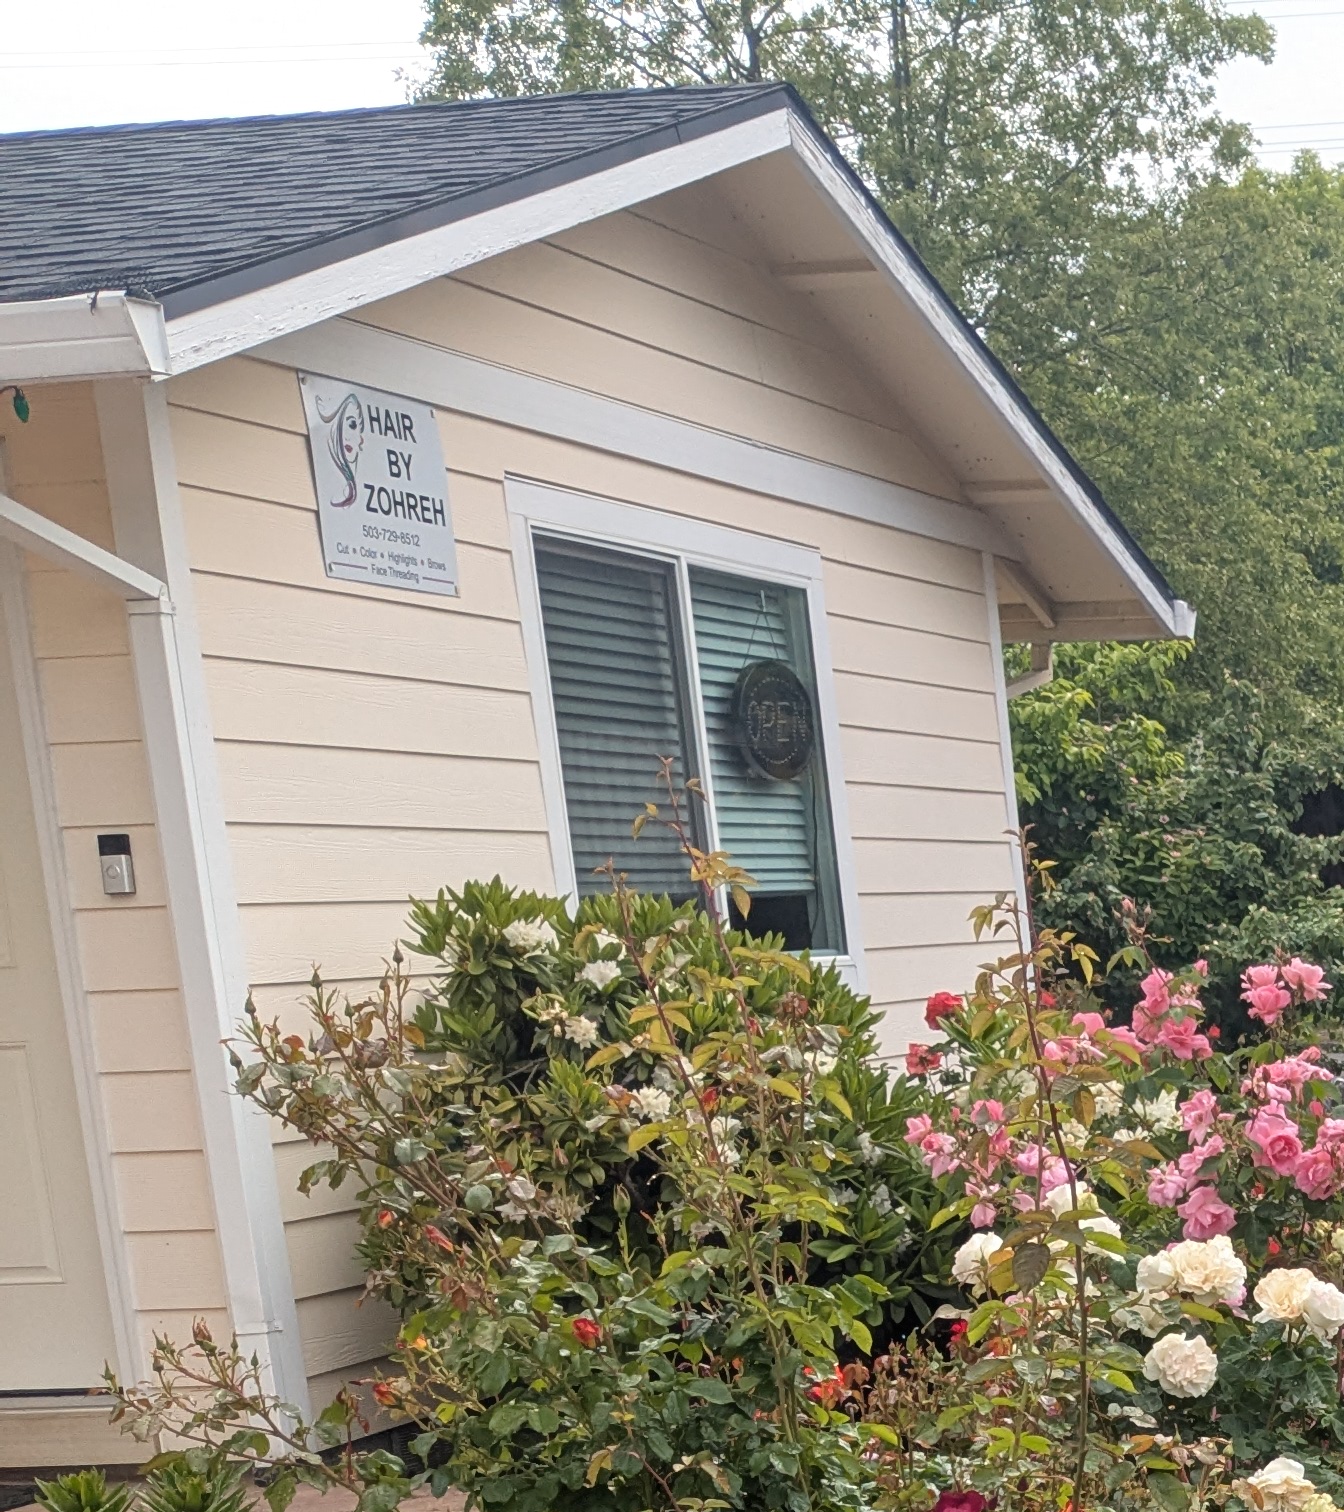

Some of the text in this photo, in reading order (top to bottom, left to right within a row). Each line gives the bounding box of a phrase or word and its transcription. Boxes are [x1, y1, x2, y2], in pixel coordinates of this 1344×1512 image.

[367, 404, 417, 444] HAIR
[386, 448, 412, 481] BY
[363, 483, 446, 527] ZOHREH
[336, 542, 446, 571] Cut Color Highlights Brows
[371, 564, 420, 584] Face Threading
[746, 701, 806, 741] OPEN
